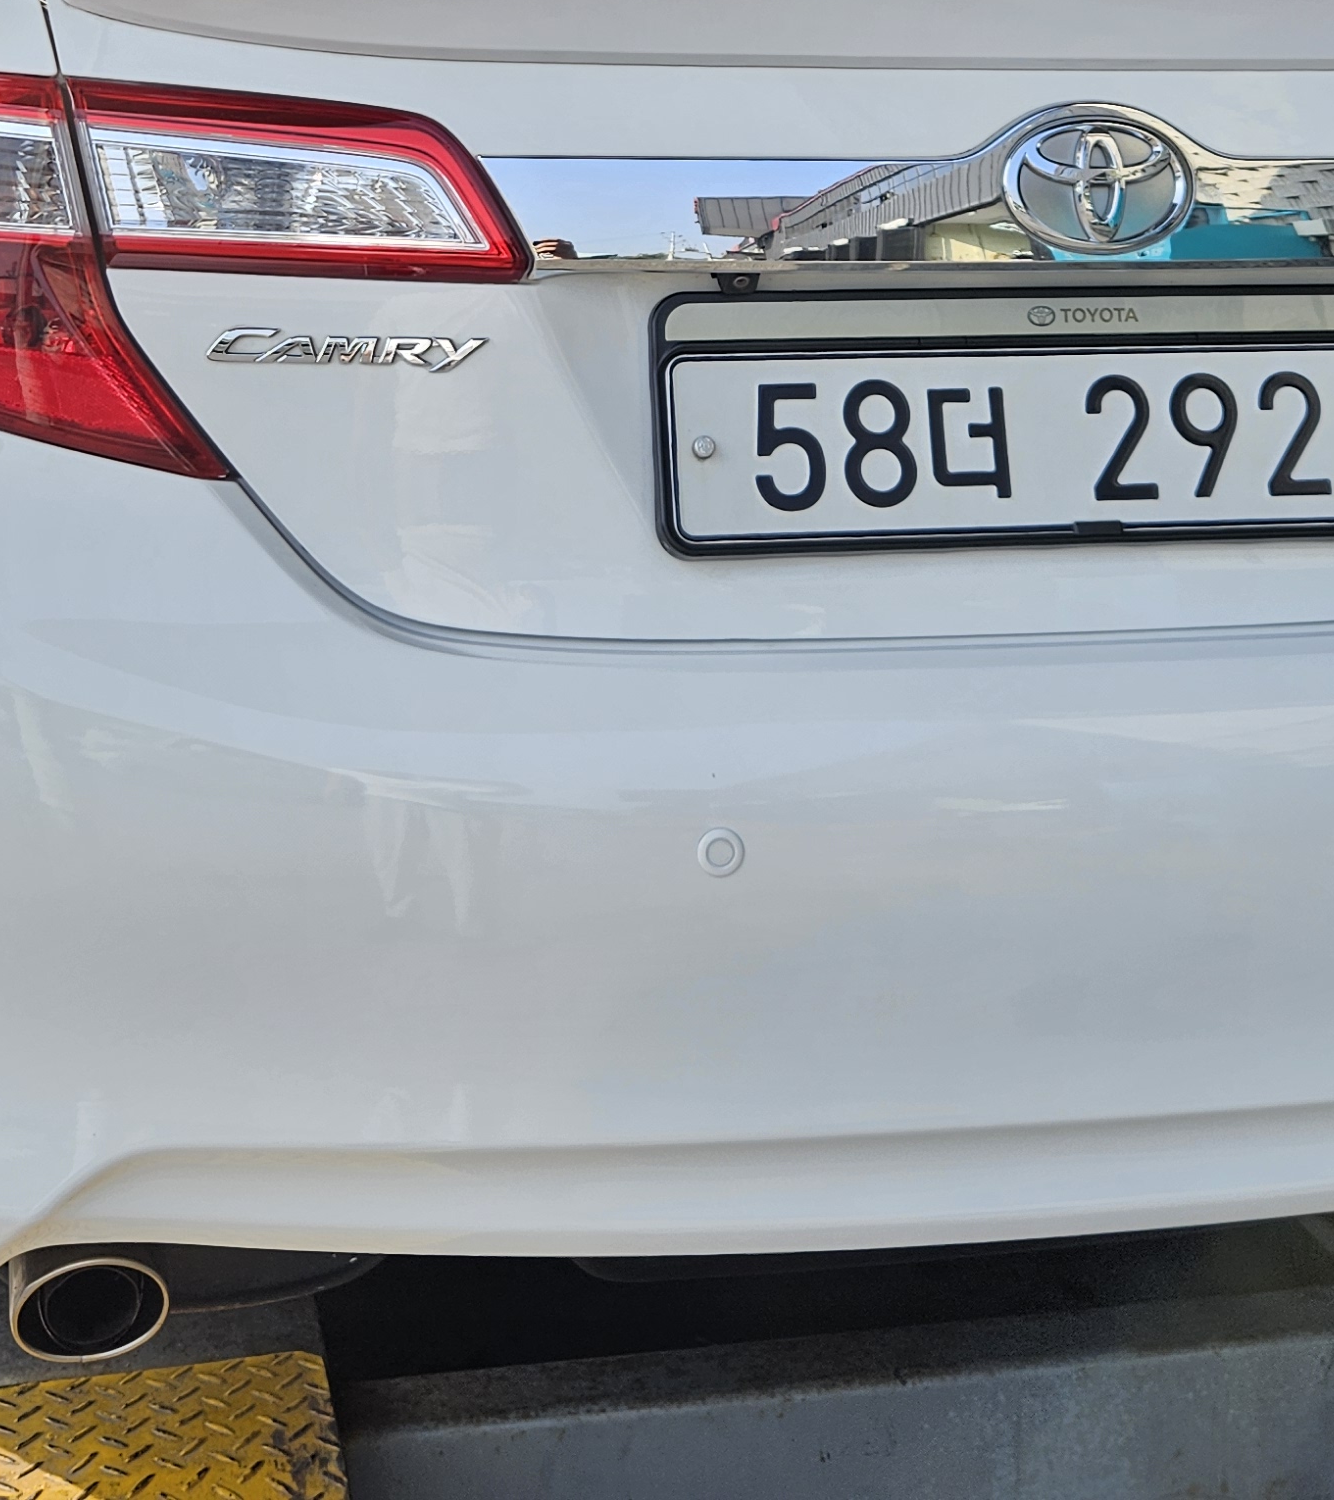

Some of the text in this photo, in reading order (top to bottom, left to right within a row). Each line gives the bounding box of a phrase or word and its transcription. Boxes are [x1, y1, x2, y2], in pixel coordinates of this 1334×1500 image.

[1060, 307, 1139, 323] TOYOTA
[206, 326, 489, 373] CAMRY
[755, 378, 1013, 512] 58더
